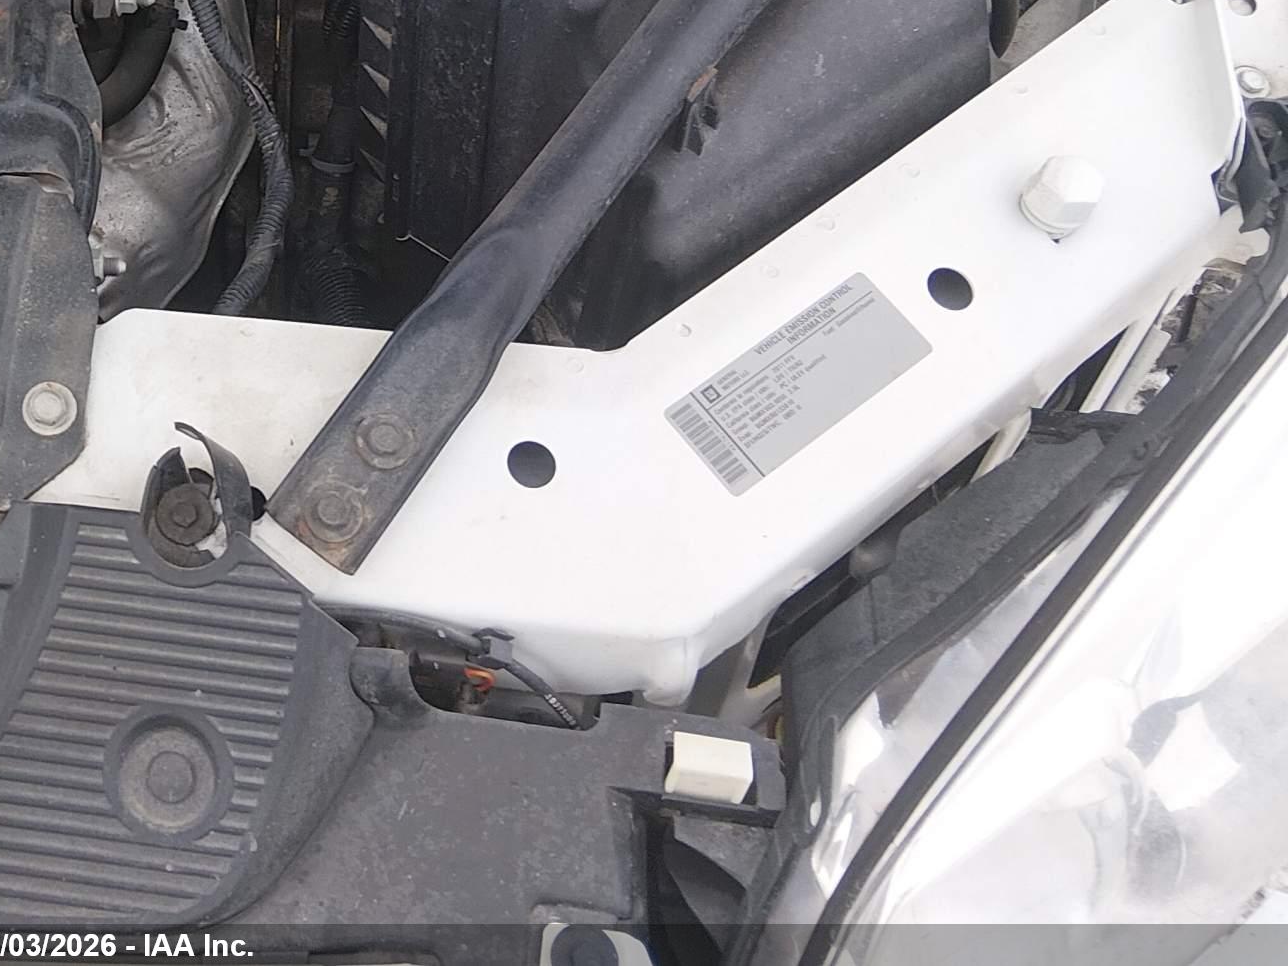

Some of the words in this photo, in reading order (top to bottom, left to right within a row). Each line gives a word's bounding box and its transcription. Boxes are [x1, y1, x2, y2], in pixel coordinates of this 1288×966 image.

[753, 330, 786, 356] VEHICLE
[784, 306, 820, 334] EMISSION
[817, 282, 852, 310] CONTROL
[785, 305, 837, 345] INFORMATION
